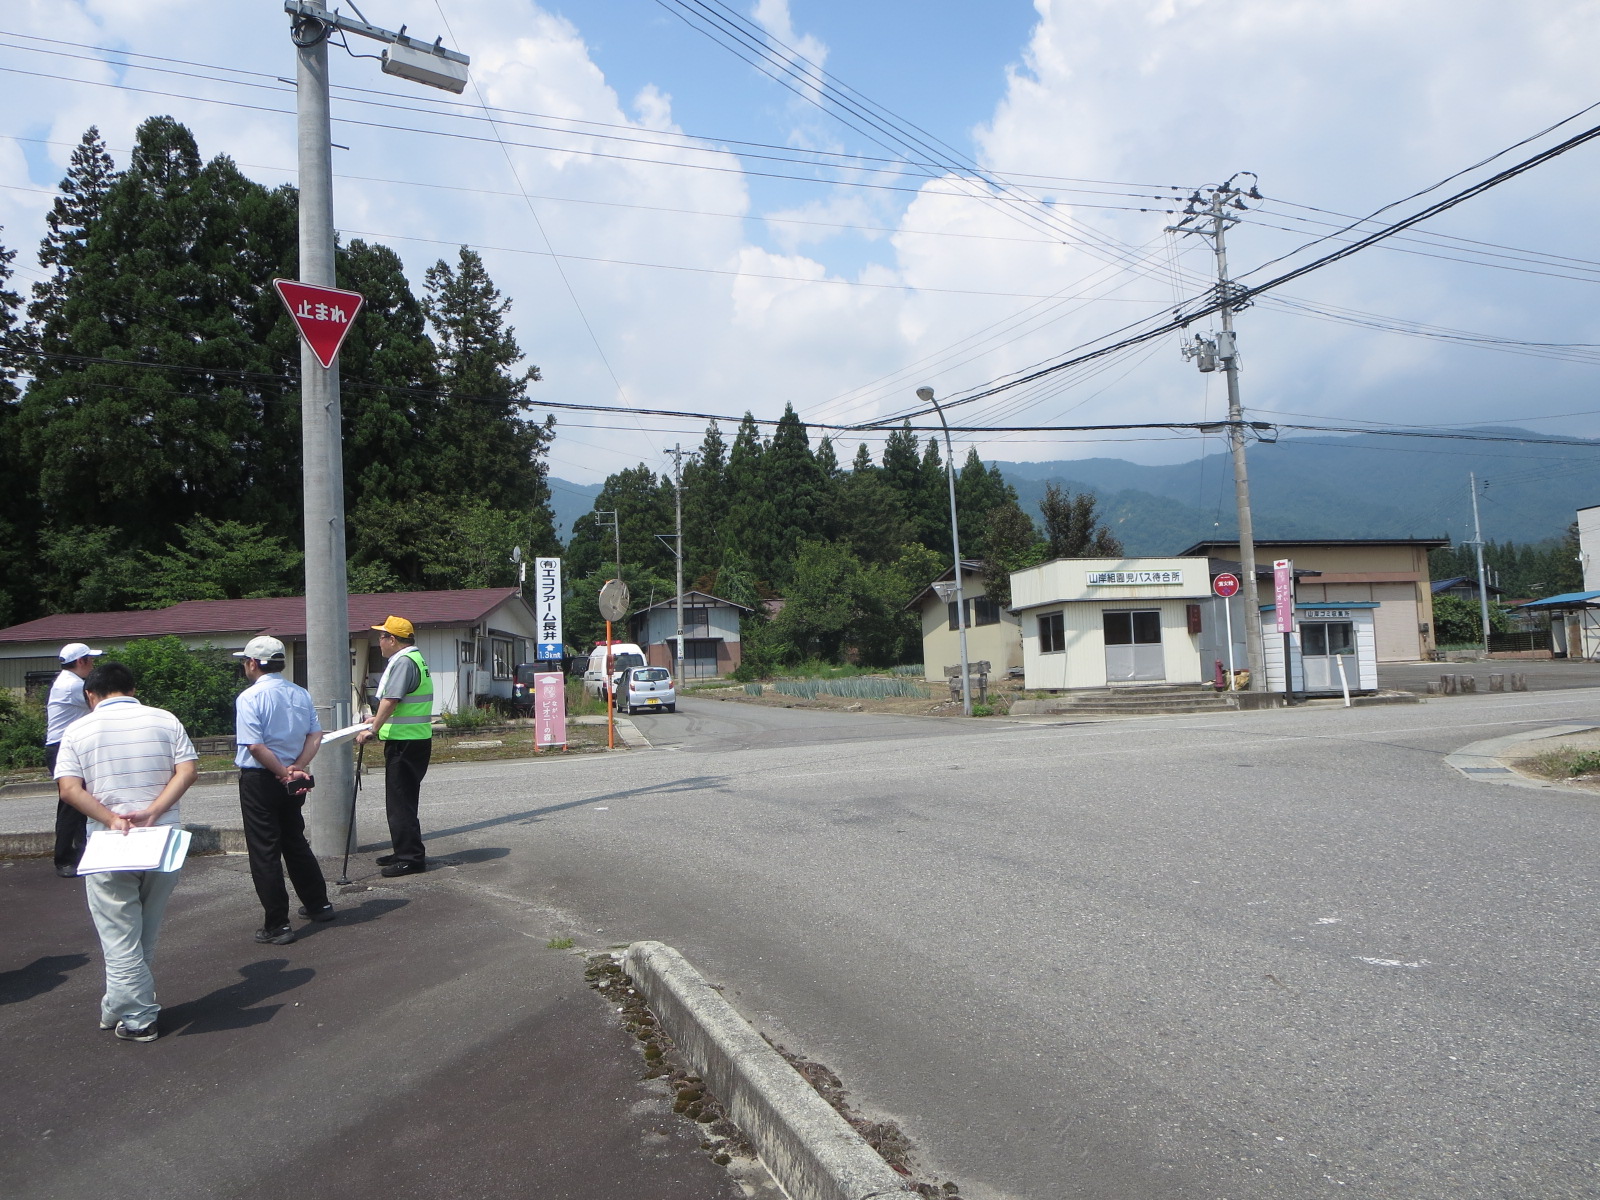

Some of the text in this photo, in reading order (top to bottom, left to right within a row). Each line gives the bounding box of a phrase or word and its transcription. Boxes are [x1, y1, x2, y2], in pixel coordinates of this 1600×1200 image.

[297, 300, 347, 323] 止まれ
[1089, 571, 1180, 583] 山岸組園児バス待合所
[540, 560, 557, 640] (有)エコファーム長井
